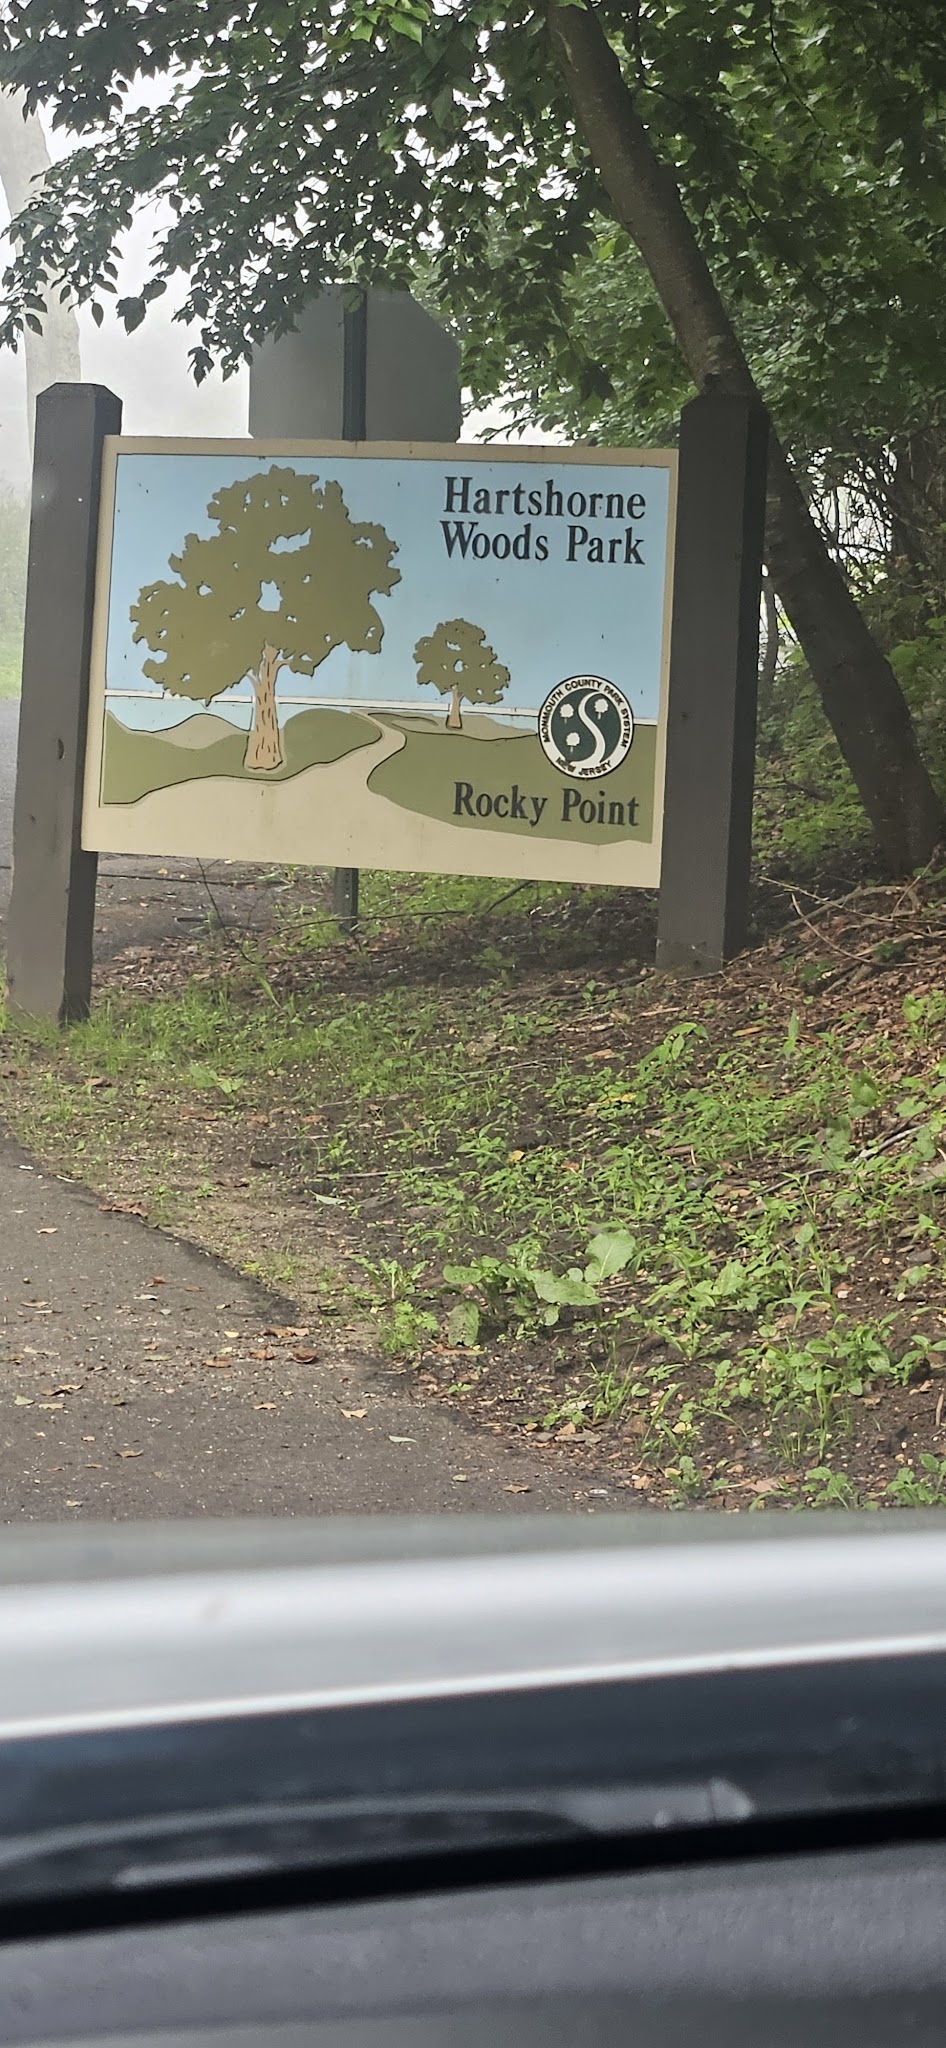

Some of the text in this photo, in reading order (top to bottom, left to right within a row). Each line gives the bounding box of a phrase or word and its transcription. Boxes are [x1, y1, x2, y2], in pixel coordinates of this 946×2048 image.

[443, 476, 646, 519] Hartshorne
[439, 520, 646, 565] Woods Park
[541, 679, 631, 748] MONMOUTH COUNTY PARK SYSTEM
[556, 757, 612, 776] NEW JERSEY
[453, 781, 640, 828] Rocky Point
